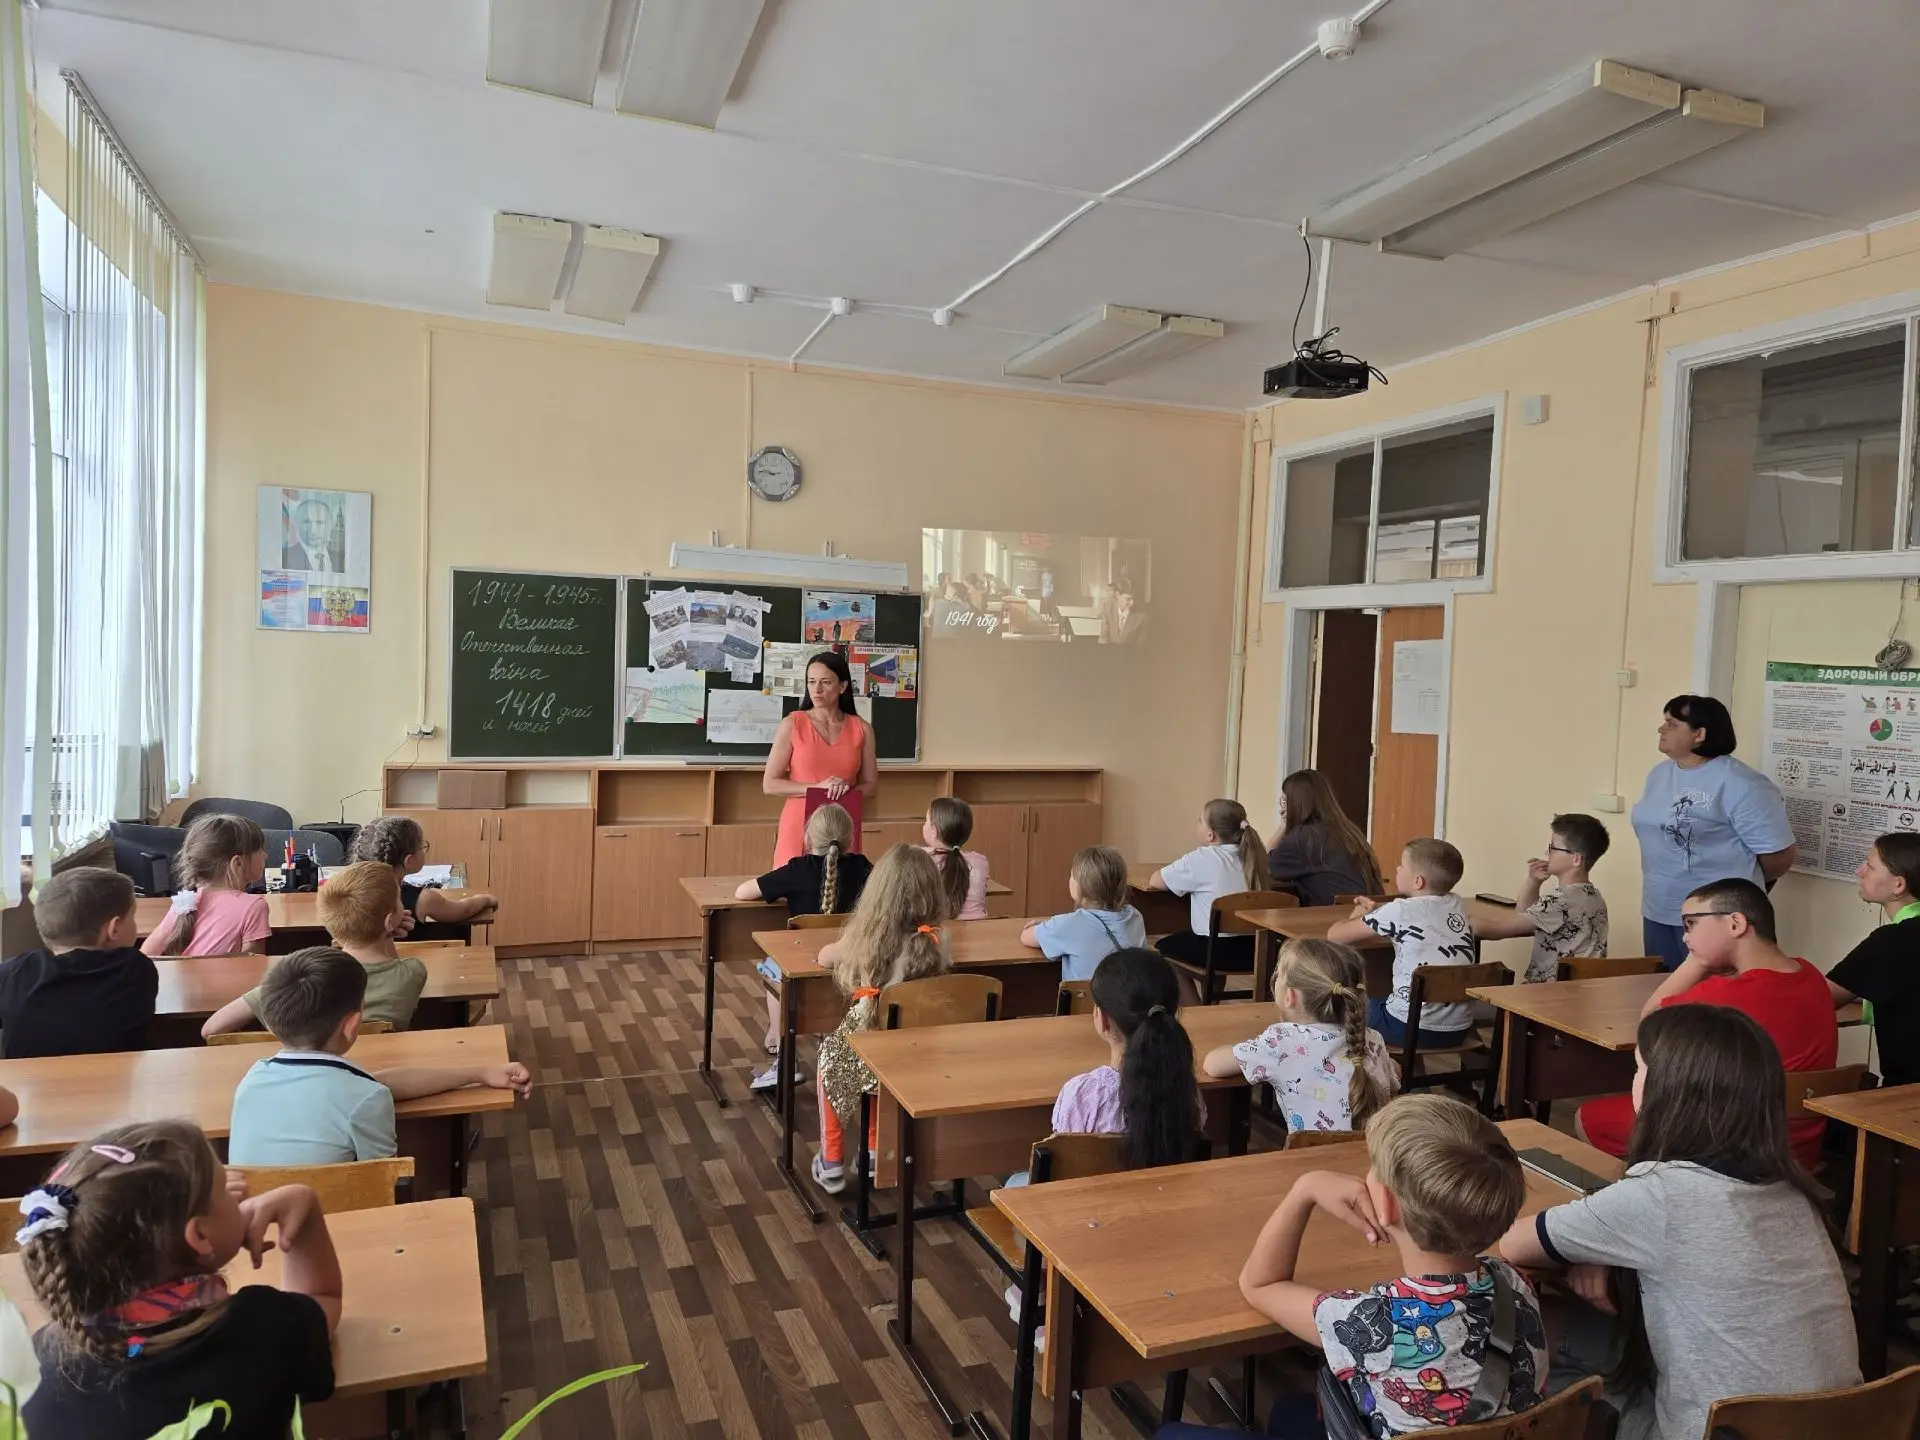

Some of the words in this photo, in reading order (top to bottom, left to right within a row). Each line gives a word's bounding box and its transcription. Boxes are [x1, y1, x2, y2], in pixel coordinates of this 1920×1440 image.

[498, 608, 580, 630] Великая
[945, 610, 974, 626] 1941
[976, 613, 999, 635] год
[1817, 668, 1888, 681] ЗДОРОВЫЙ
[495, 688, 556, 718] 1418
[556, 704, 593, 725] дней
[482, 719, 494, 731] и
[507, 720, 551, 735] ночей
